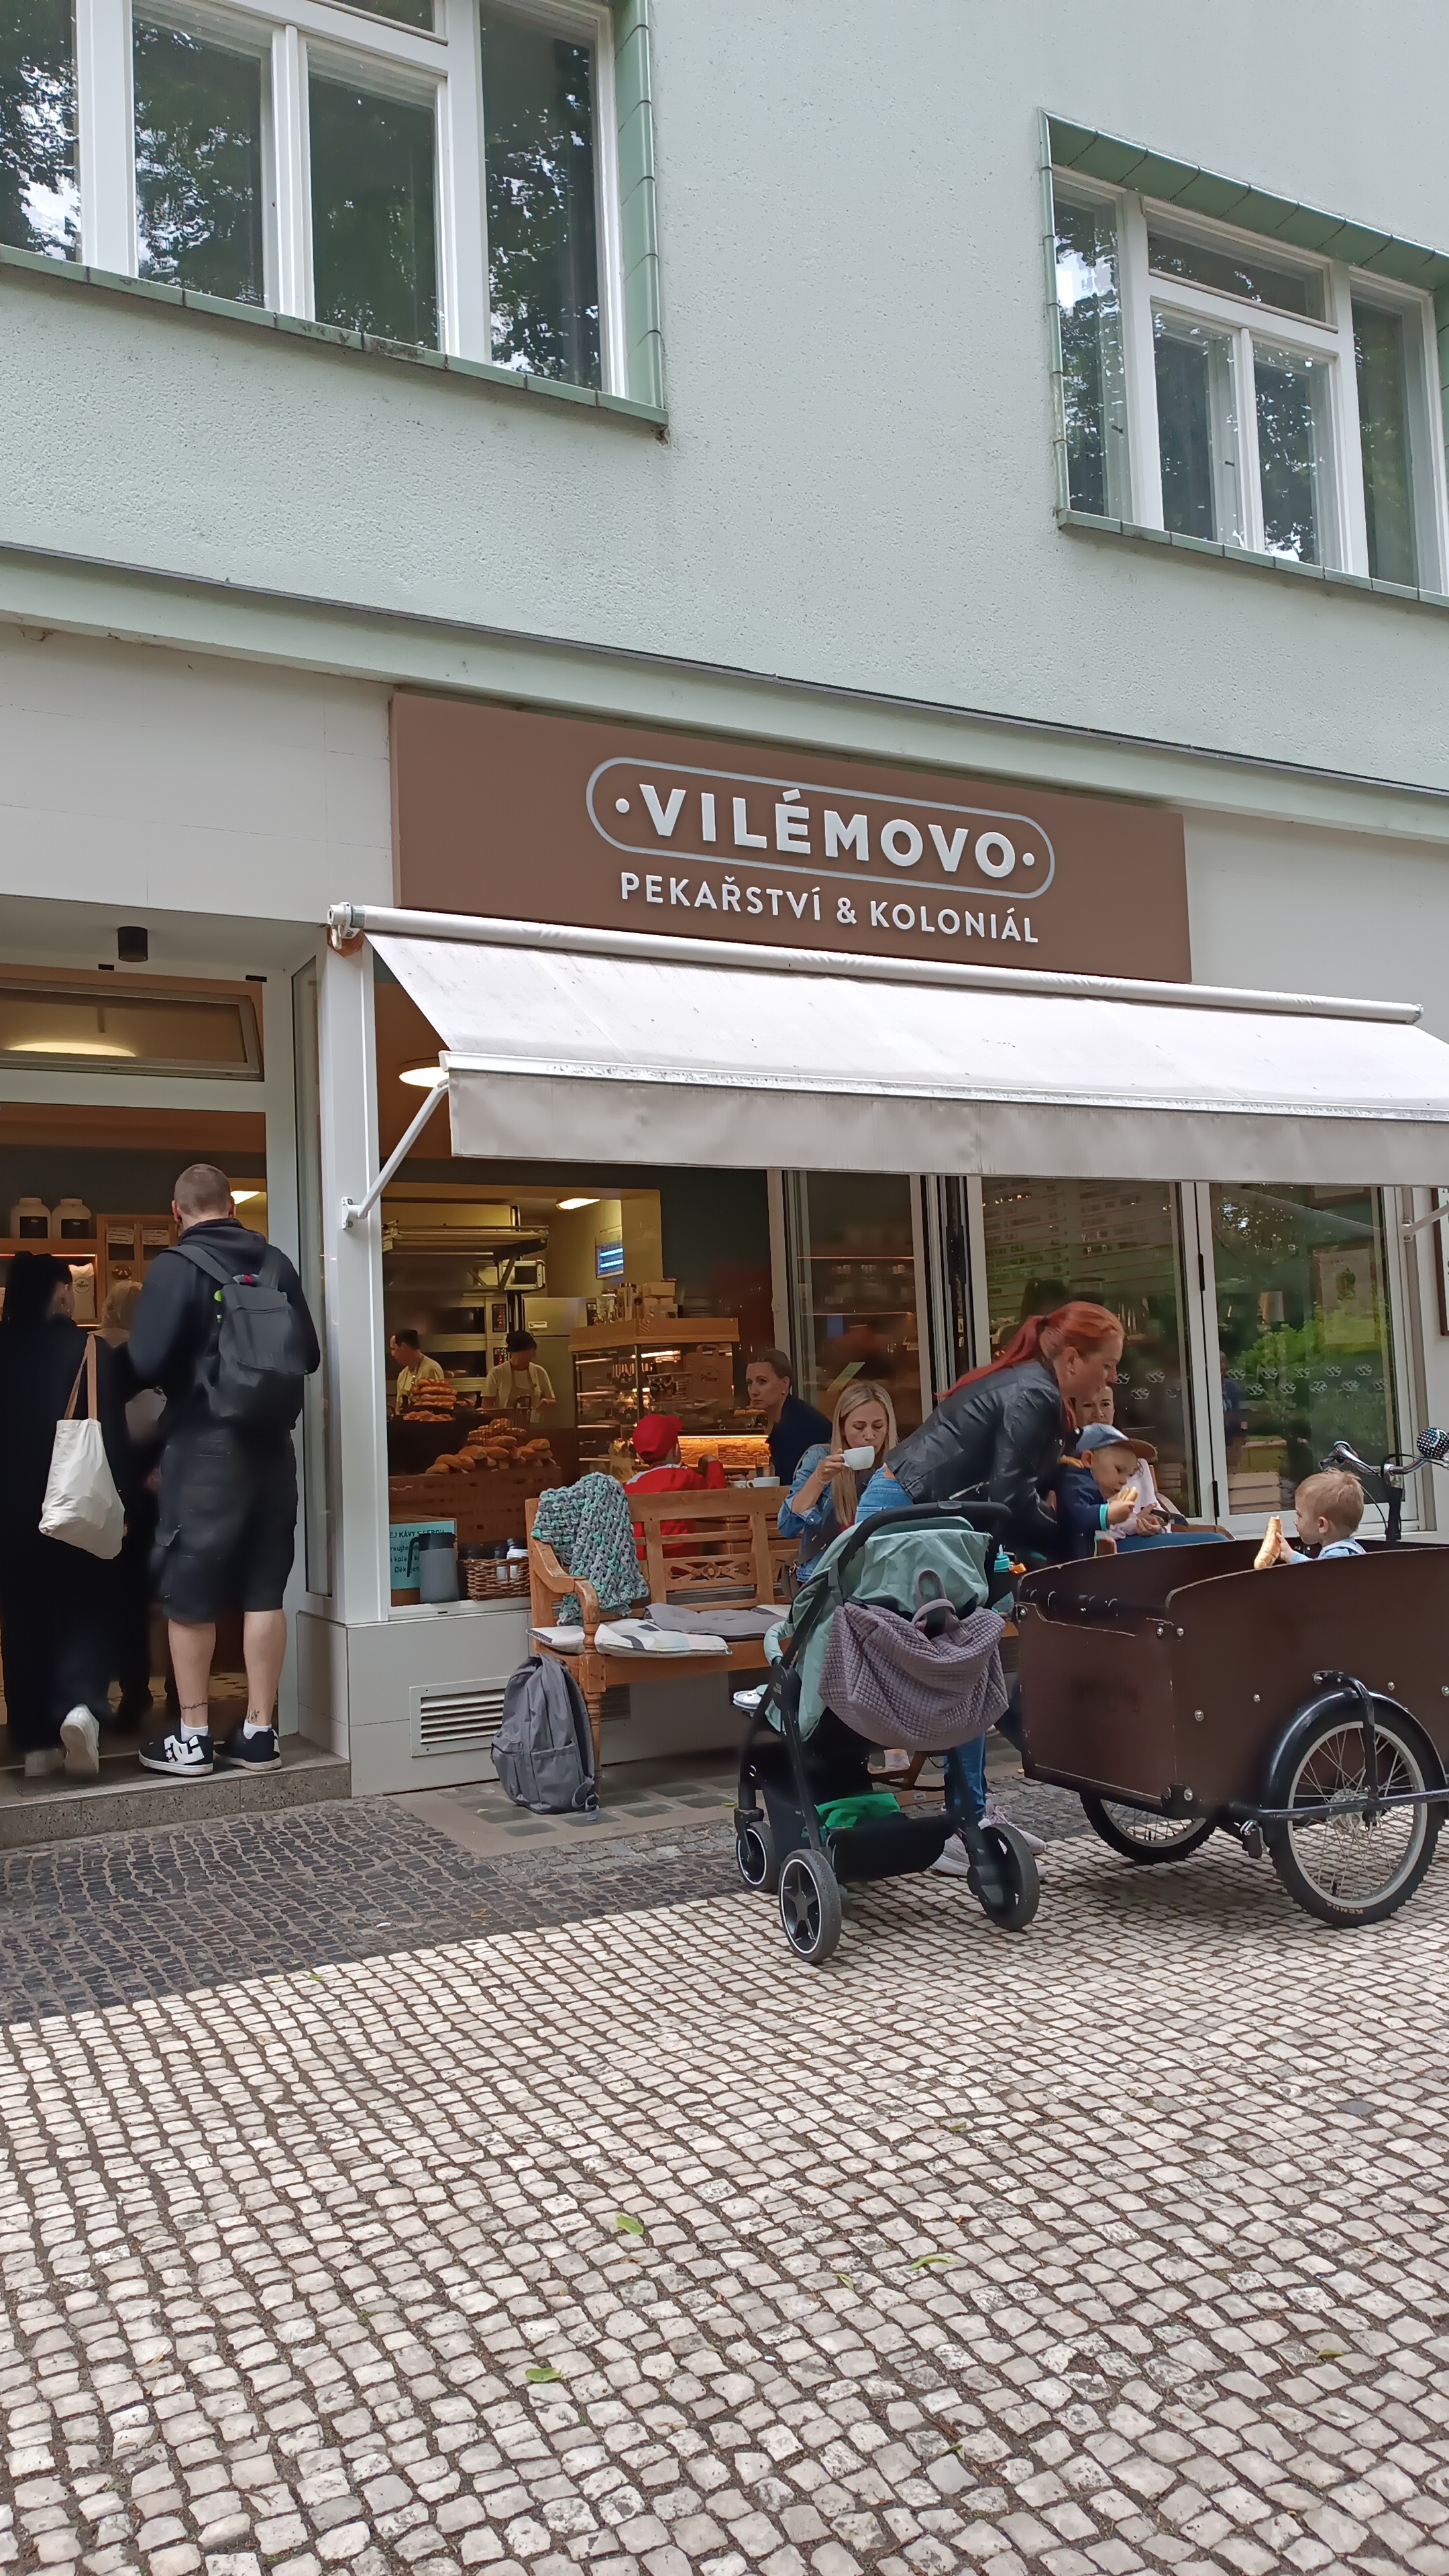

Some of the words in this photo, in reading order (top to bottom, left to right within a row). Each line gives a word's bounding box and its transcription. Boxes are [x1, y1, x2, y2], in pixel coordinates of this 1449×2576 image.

[639, 784, 1016, 878] VILÉMOVO
[621, 871, 821, 922] PEKAŘSTVÍ
[837, 897, 857, 924] &
[870, 900, 1038, 943] KOLONIÁL
[1326, 1900, 1364, 1915] KENDA
